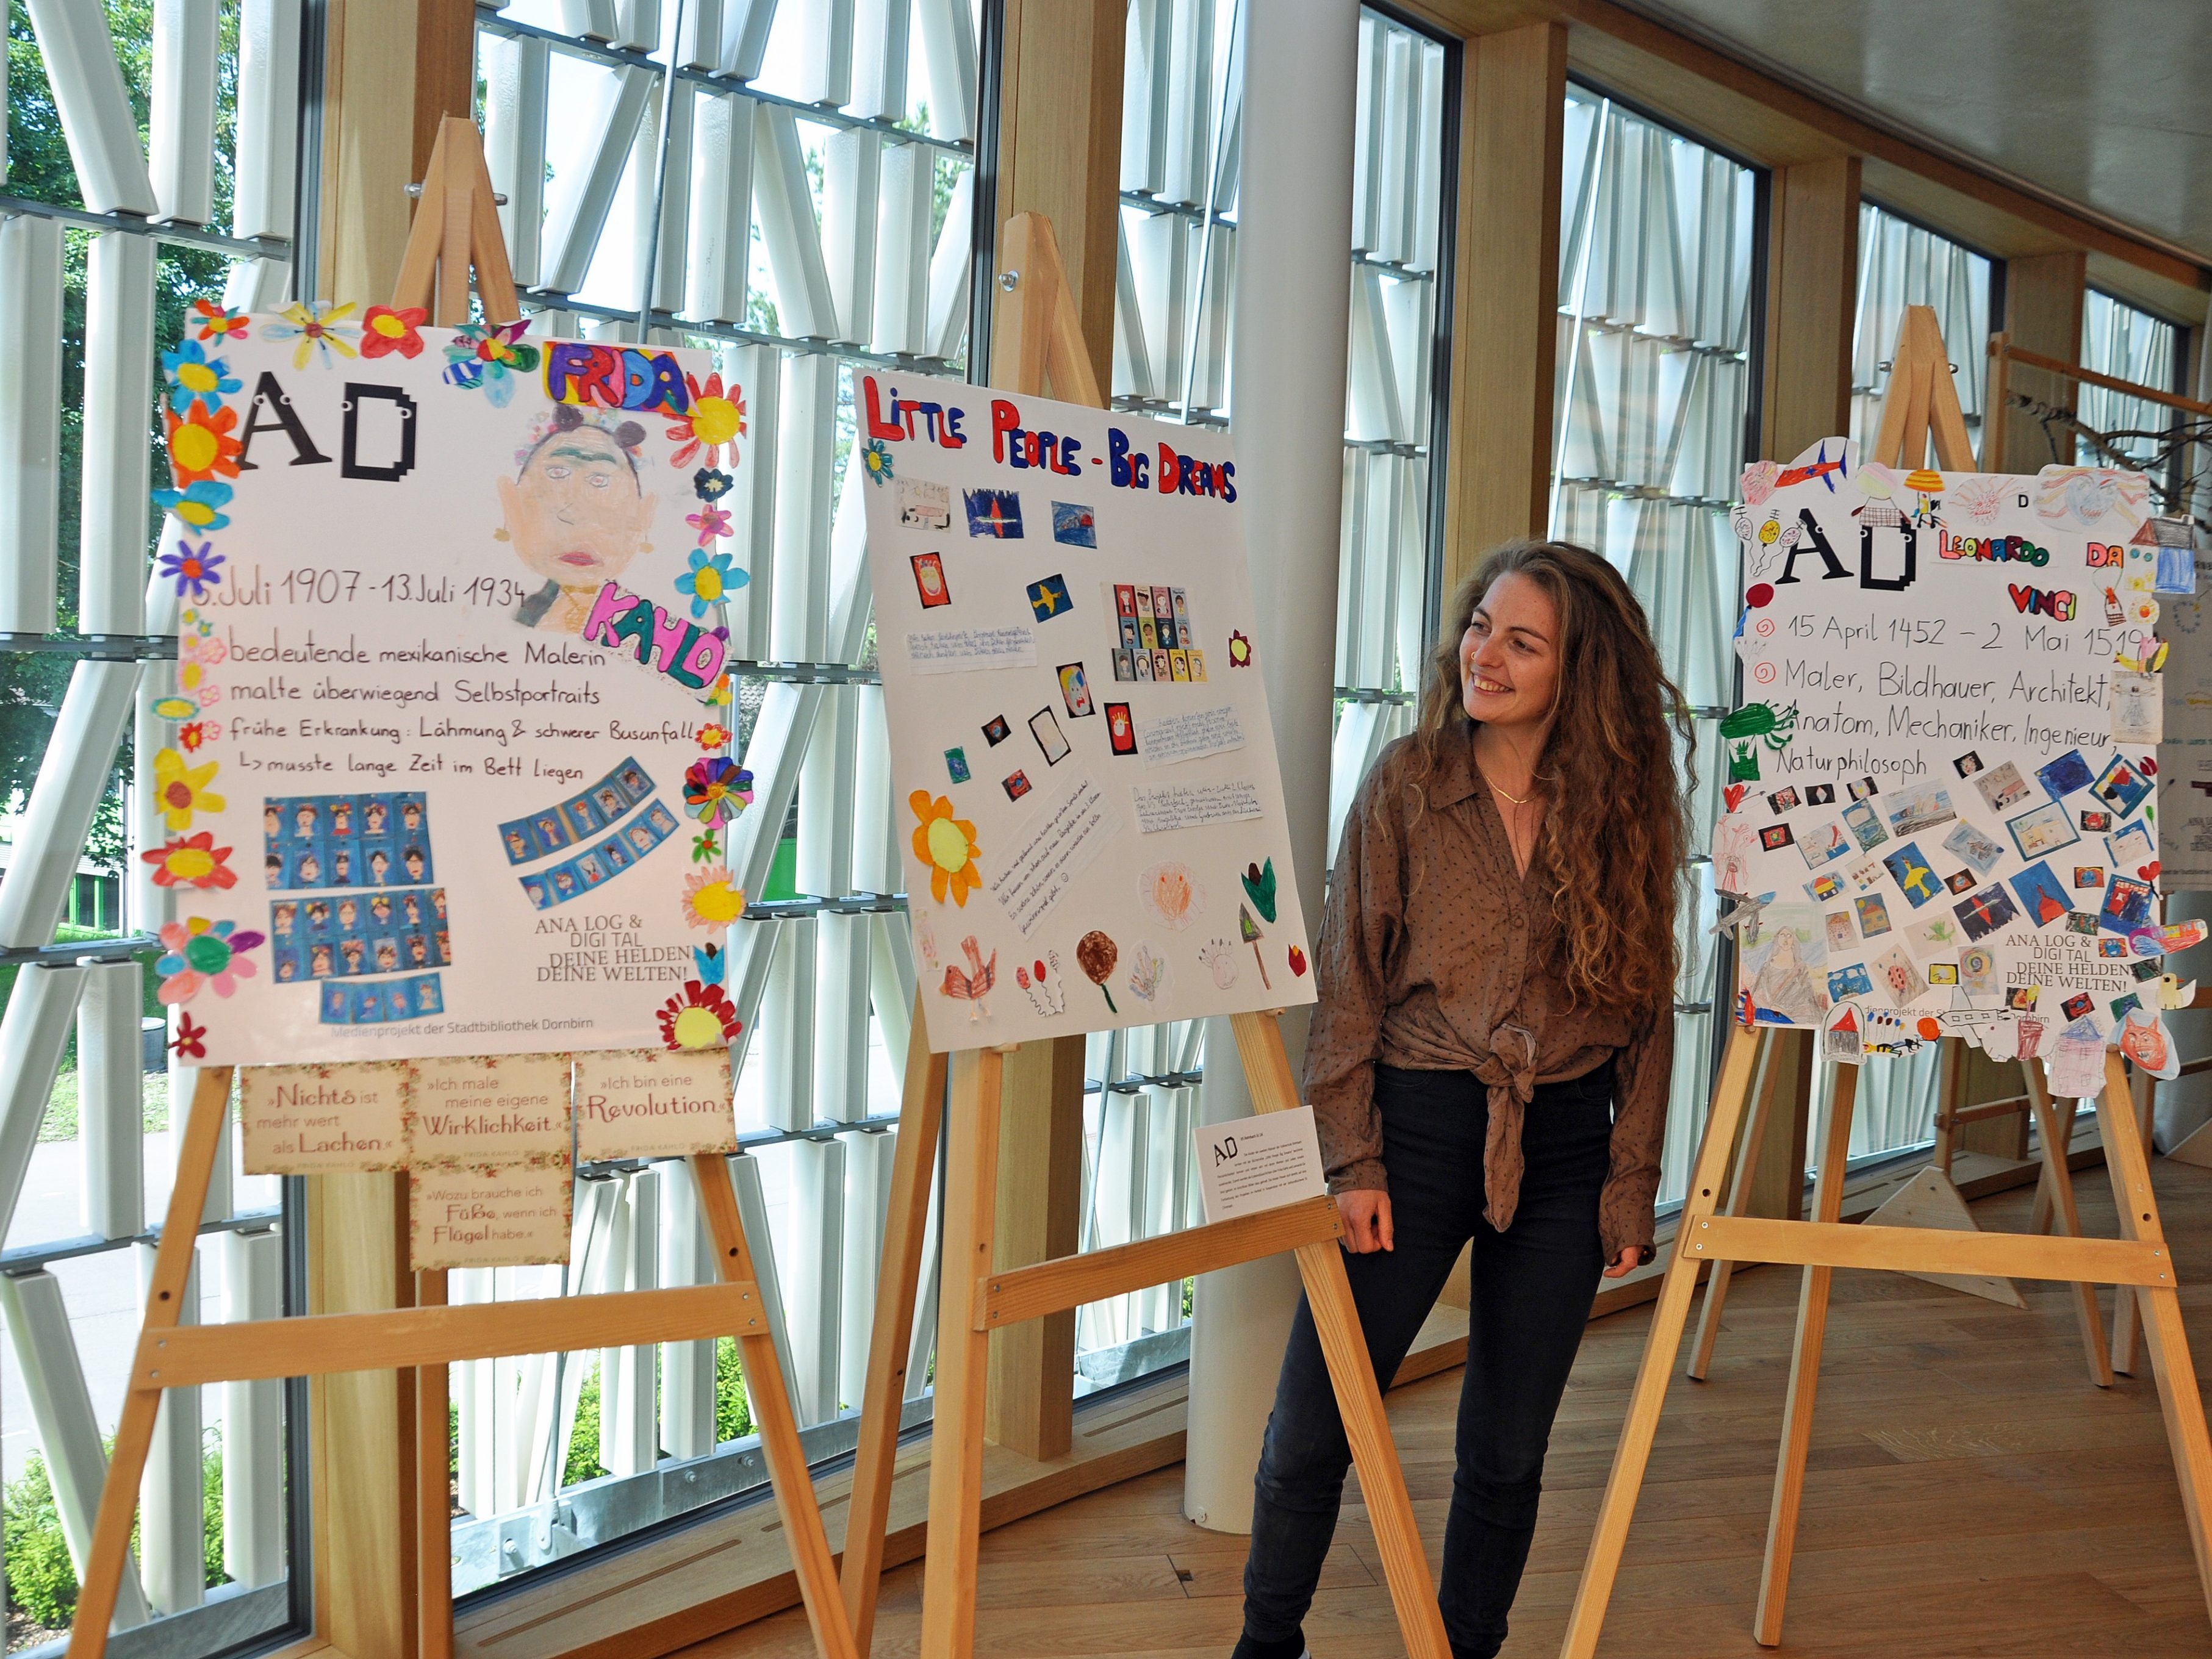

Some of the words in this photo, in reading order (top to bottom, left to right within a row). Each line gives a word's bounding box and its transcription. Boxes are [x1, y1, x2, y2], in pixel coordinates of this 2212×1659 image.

[549, 342, 689, 413] FRIDA
[991, 400, 1082, 476] PEOPLE
[1108, 428, 1149, 489] BIG
[1158, 442, 1237, 503] DREAMS
[2019, 495, 2028, 509] D
[1939, 529, 2050, 568] LEONARDO
[2086, 542, 2124, 568] DA
[281, 568, 361, 604] 1907
[463, 576, 526, 606] 1934
[2008, 583, 2077, 622] VINCI
[228, 625, 370, 663] bedeutende
[379, 638, 510, 664] mexikanische
[525, 642, 606, 665] Malerin
[584, 582, 725, 689] KAHLO
[1789, 615, 1815, 637] 15
[1823, 613, 1878, 649] April
[1889, 618, 1945, 648] 1452
[1981, 622, 2003, 649] 2
[2025, 625, 2069, 651] Mai
[2084, 628, 2144, 661] 1519
[230, 675, 301, 700] malte
[313, 676, 439, 709] überwiegend
[454, 679, 600, 706] Selbstportraits
[1786, 658, 1862, 693] Maler,
[1879, 661, 1996, 703] Bildhauer,
[2009, 669, 2110, 711] Architekt,
[228, 716, 287, 740] frühe
[420, 716, 507, 747] Lähmung
[512, 720, 526, 736] &
[535, 722, 600, 739] schwerer
[610, 720, 694, 744] Busunfall
[1781, 699, 1879, 737] Anatom,
[1888, 704, 2016, 742] Mechaniker,
[2024, 714, 2117, 756] Ingenieur,
[267, 753, 334, 772] musste
[348, 754, 397, 777] lange
[409, 753, 443, 772] Zeit
[453, 761, 473, 774] im
[484, 757, 522, 776] Bett
[1776, 745, 1927, 785] Naturphilosoph
[535, 917, 578, 933] ANA
[584, 914, 623, 931] LOG
[629, 914, 642, 928] &
[570, 932, 605, 947] DIGI
[611, 932, 642, 947] TAL
[2006, 934, 2040, 946] ANA
[2045, 935, 2075, 947] LOG
[2081, 936, 2091, 947] &
[550, 950, 608, 968] DEINE
[2033, 947, 2061, 960] DIGI
[2066, 949, 2092, 962] TAL
[537, 966, 595, 981] DEINE
[603, 966, 688, 981] WELTEN!
[2016, 962, 2063, 975] DEINE
[2006, 972, 2053, 987] DEINE
[2059, 976, 2127, 992] WELTEN!
[1919, 1008, 1934, 1017] der
[331, 1026, 420, 1039] Medienprojekt
[424, 1025, 443, 1034] der
[447, 1020, 538, 1034] Stadtbibliothek
[542, 1018, 593, 1030] Dornbirn
[462, 1076, 499, 1090] male
[634, 1075, 657, 1087] bin
[662, 1074, 692, 1087] eine
[361, 1091, 378, 1103] ist
[445, 1095, 491, 1108] meine
[497, 1094, 548, 1110] eigene
[257, 1115, 299, 1128] mehr
[304, 1116, 340, 1127] wert
[273, 1141, 294, 1154] als
[472, 1188, 521, 1200] brauche
[525, 1186, 543, 1197] ich
[503, 1210, 535, 1219] wenn
[539, 1206, 556, 1217] ich
[433, 1225, 488, 1245] Flügel
